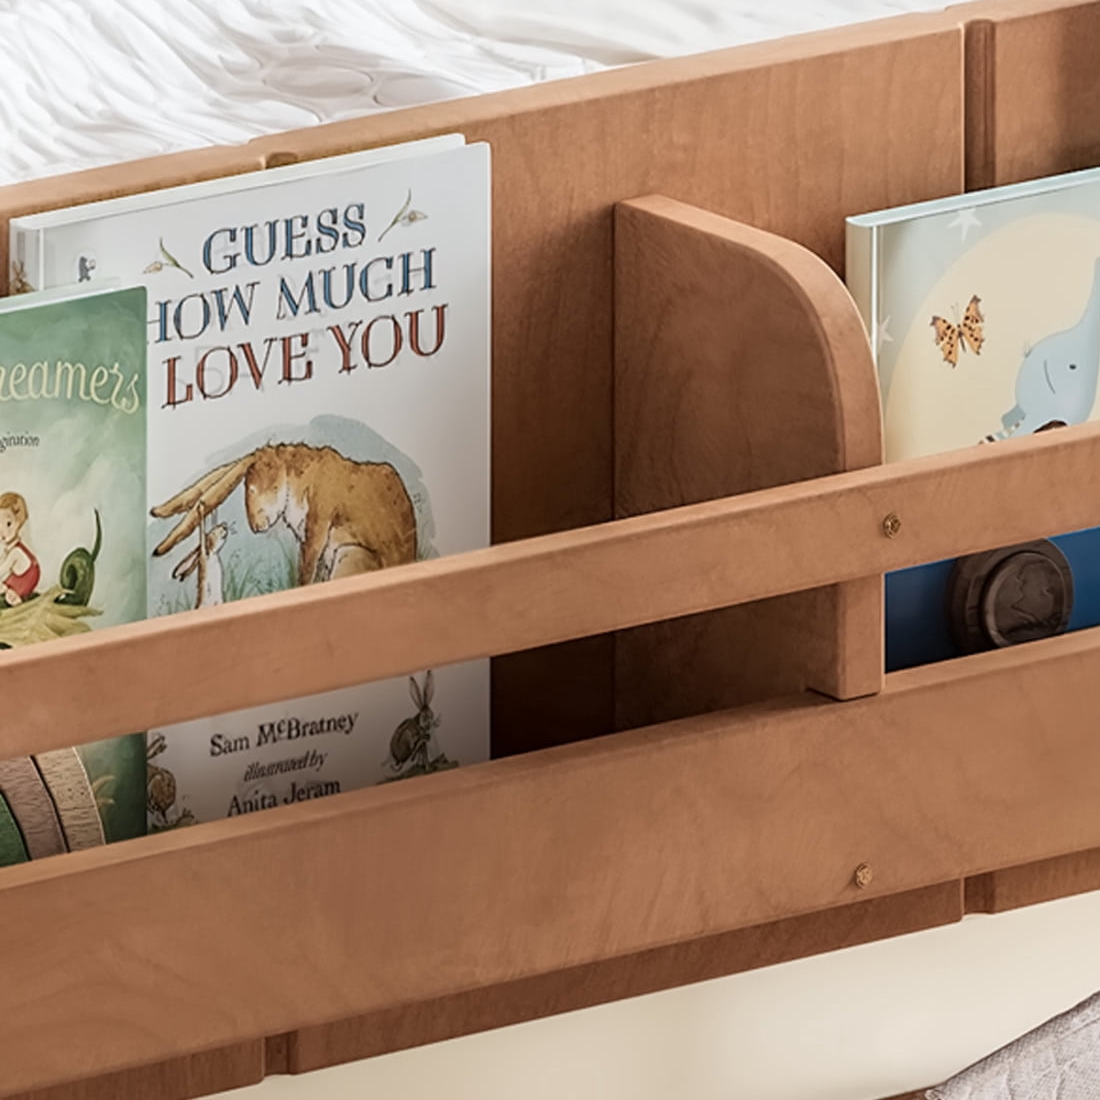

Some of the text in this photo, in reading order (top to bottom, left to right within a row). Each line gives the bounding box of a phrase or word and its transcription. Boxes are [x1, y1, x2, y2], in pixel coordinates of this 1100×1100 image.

[202, 203, 367, 275] GUESS
[276, 247, 437, 320] MUCH
[161, 304, 449, 410] LOVE YOU
[210, 711, 359, 757] Sam McBratney
[227, 779, 342, 818] Anita Jeram
